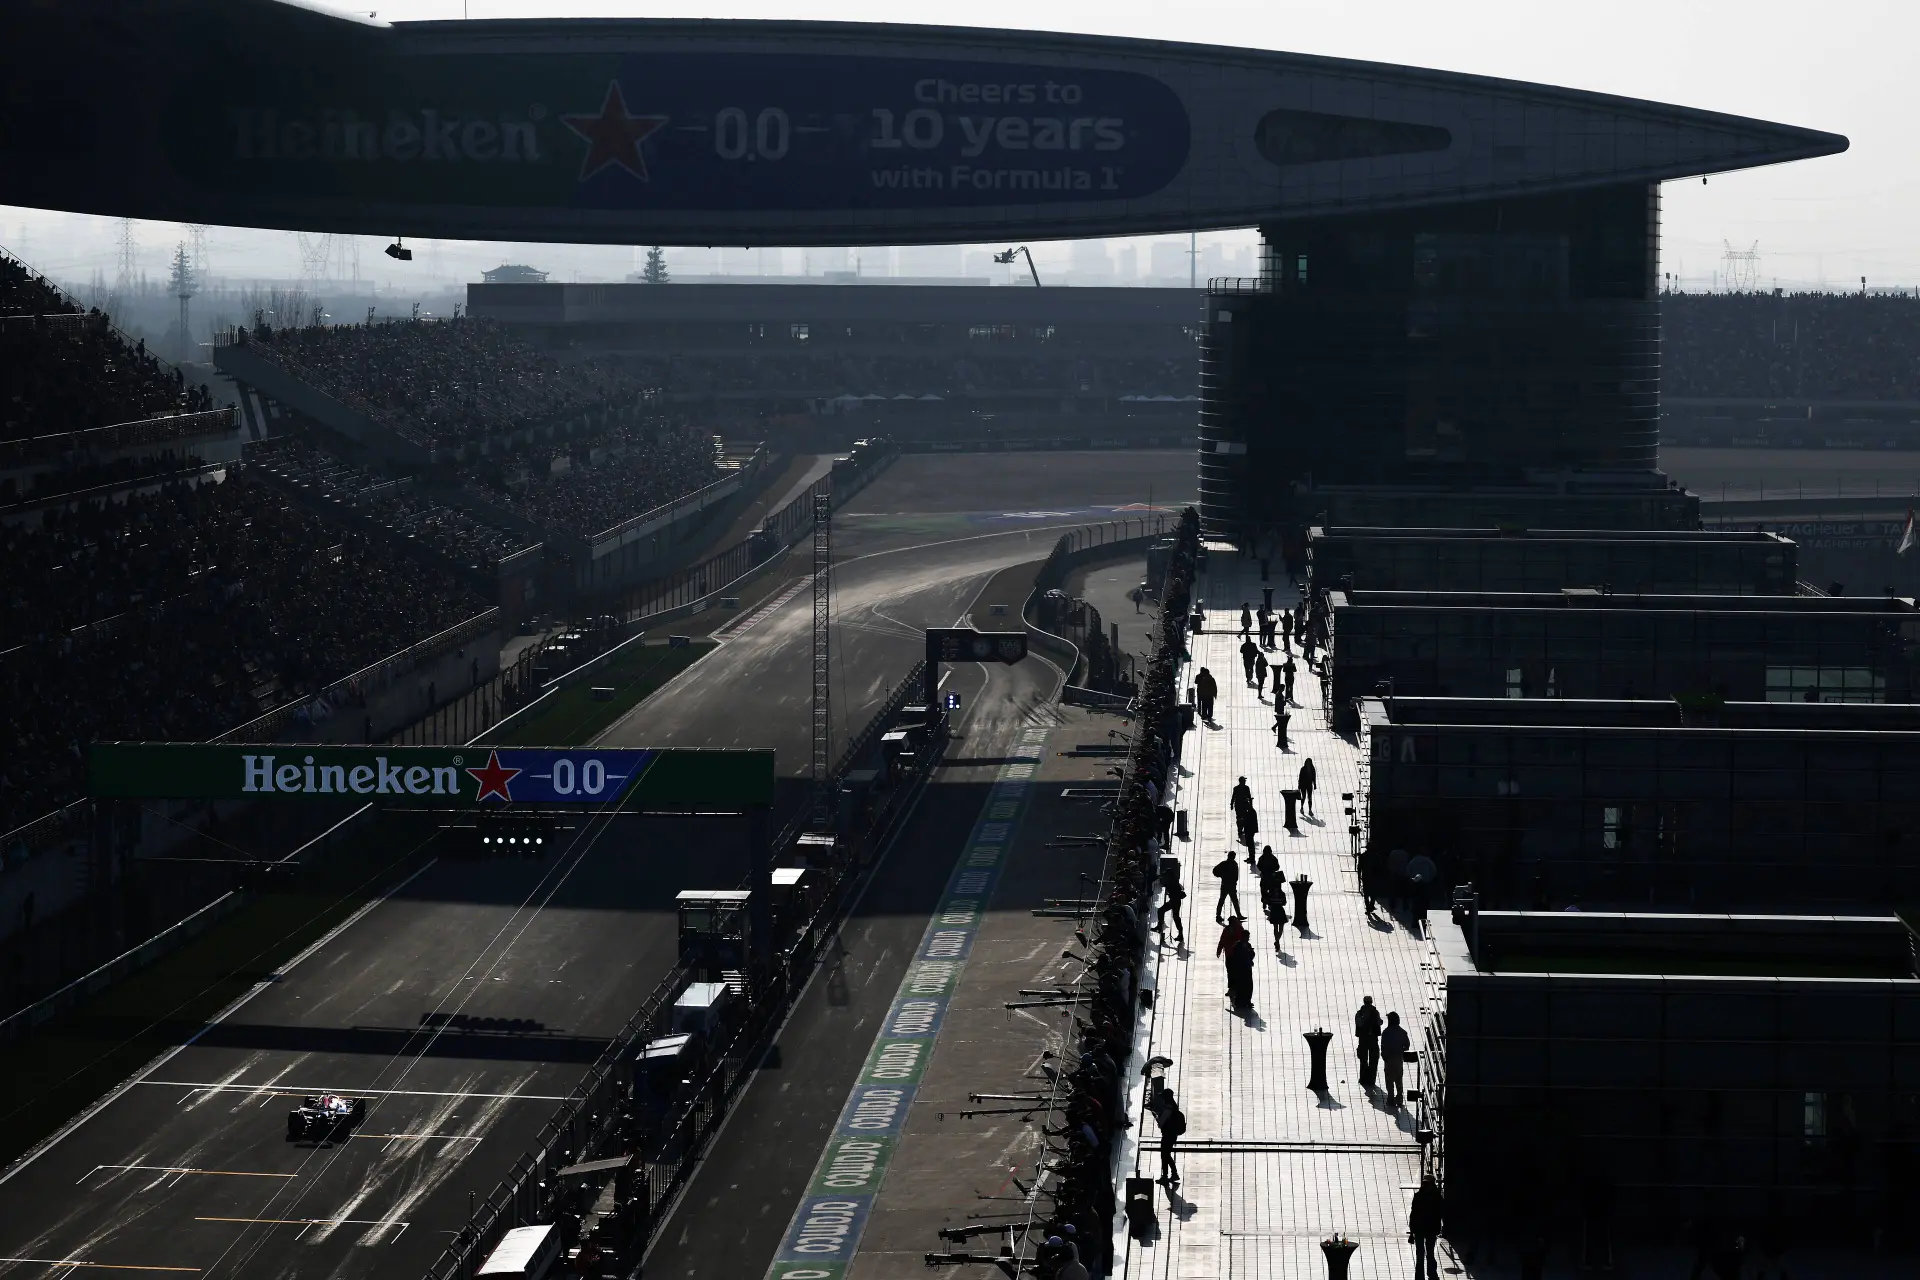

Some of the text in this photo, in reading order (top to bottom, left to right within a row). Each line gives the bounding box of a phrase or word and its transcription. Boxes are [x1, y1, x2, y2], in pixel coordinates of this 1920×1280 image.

[913, 79, 1084, 104] Cheers to
[870, 108, 1125, 157] 10 years
[871, 166, 943, 189] with
[951, 165, 1091, 190] Formula
[892, 1001, 939, 1033] aramco
[871, 1043, 923, 1078] aramco
[848, 1089, 904, 1129] aramco
[823, 1142, 882, 1187] aramco
[793, 1201, 858, 1253] aramco
